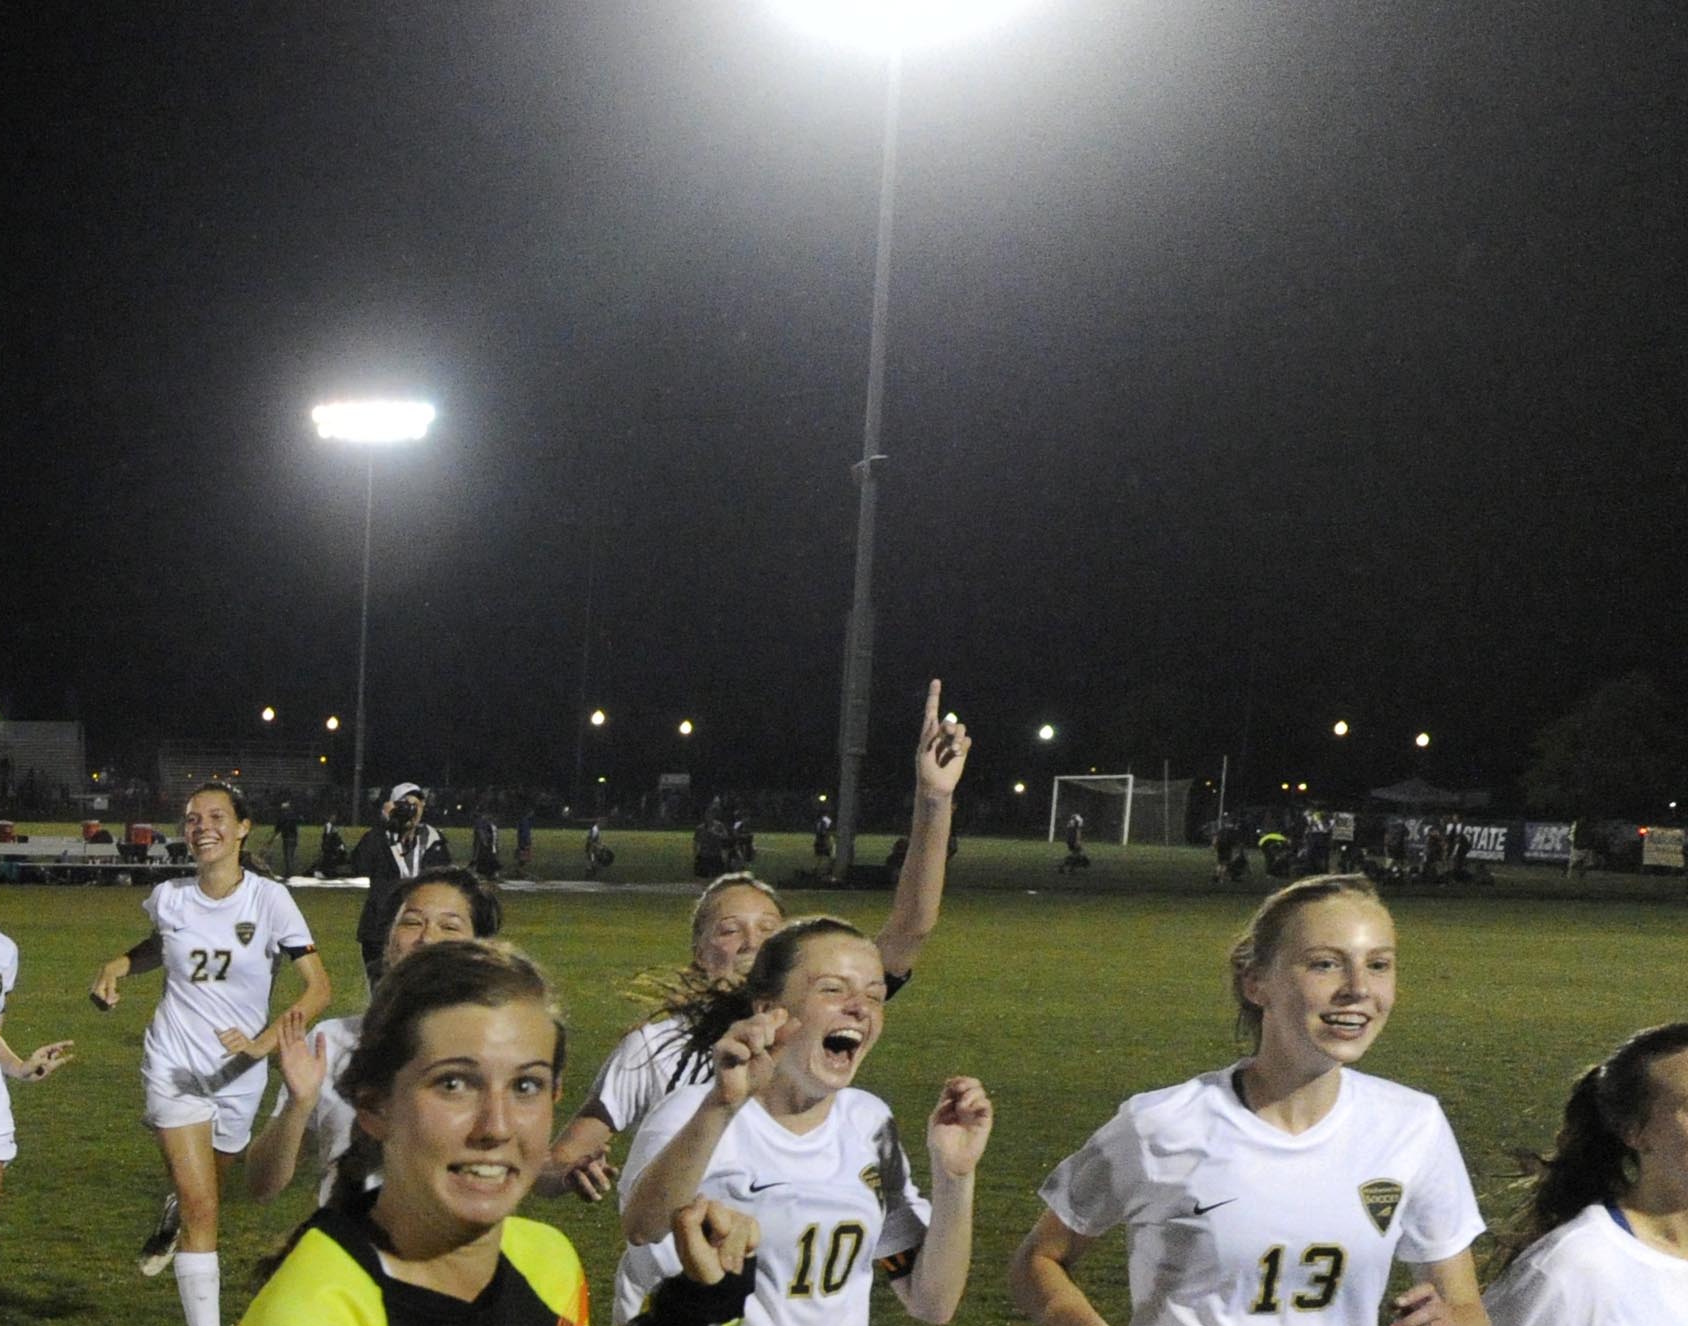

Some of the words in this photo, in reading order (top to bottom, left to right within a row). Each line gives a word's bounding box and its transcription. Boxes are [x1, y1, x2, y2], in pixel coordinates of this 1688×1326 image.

[1463, 826, 1508, 850] STATE
[190, 949, 232, 982] 27
[787, 1220, 868, 1299] 10
[1248, 1242, 1349, 1315] 13
